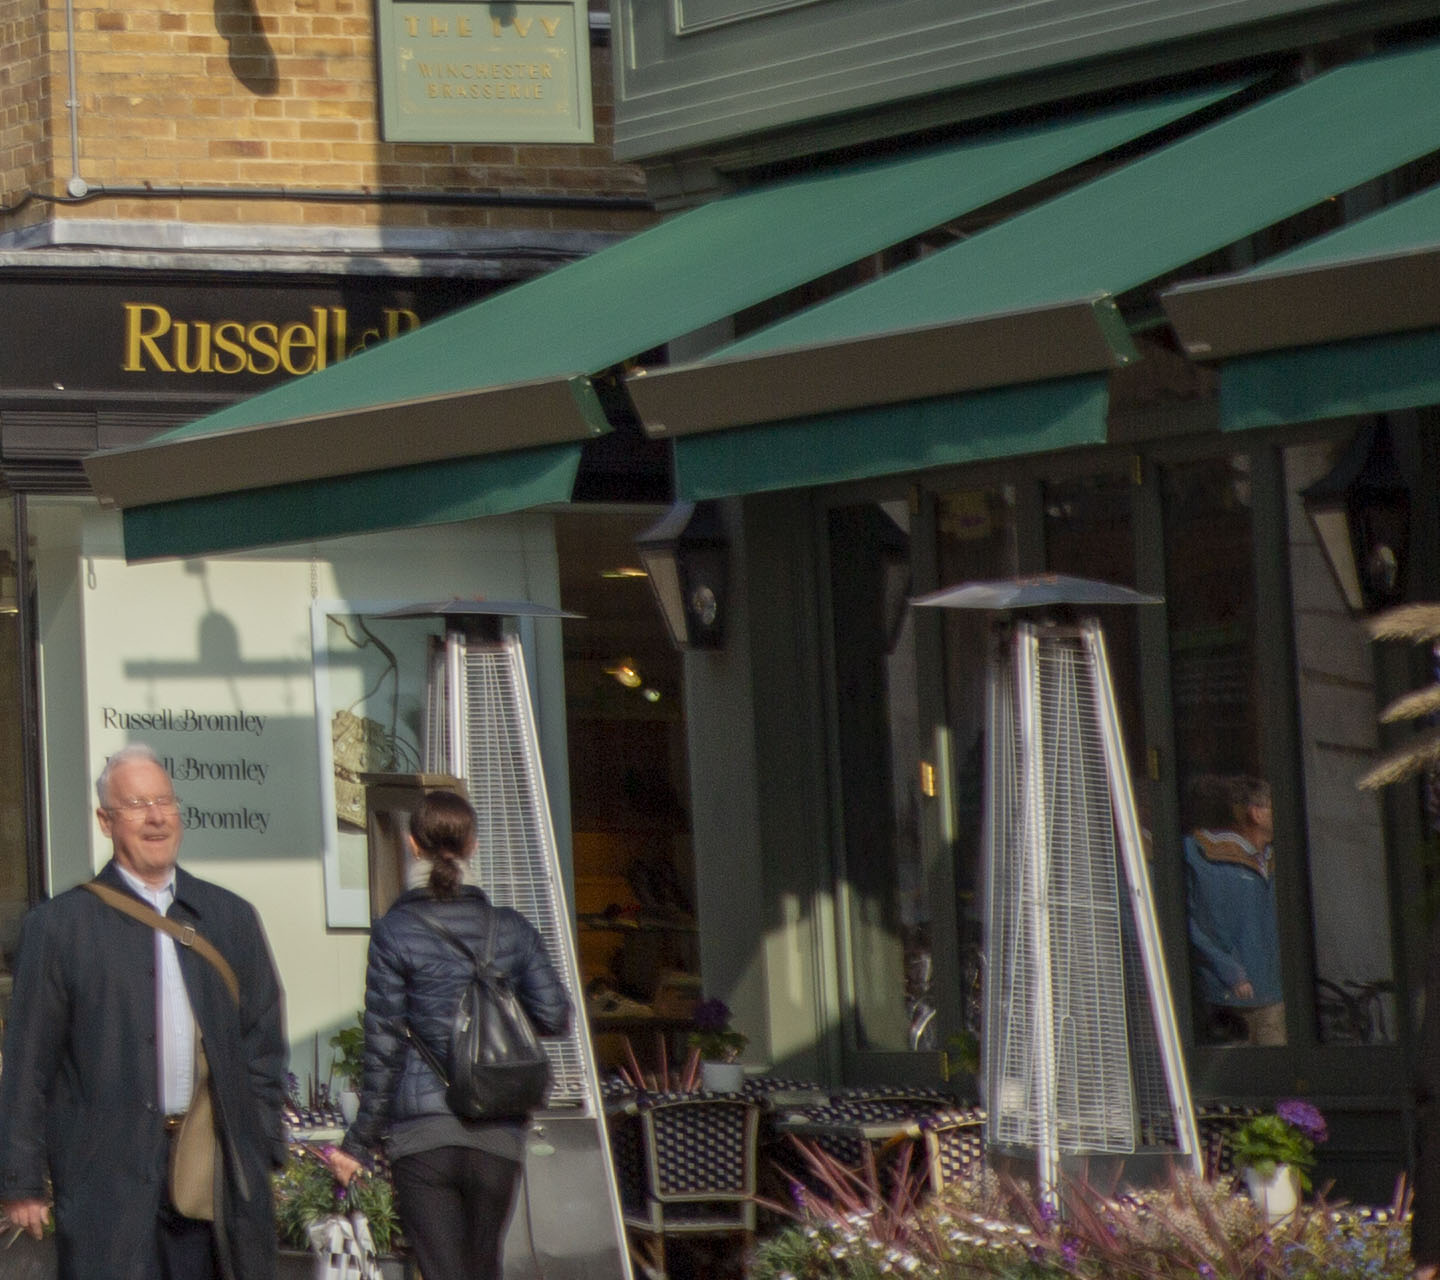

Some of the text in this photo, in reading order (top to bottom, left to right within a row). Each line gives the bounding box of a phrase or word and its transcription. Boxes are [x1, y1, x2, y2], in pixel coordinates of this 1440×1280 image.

[404, 15, 561, 39] THE IVY
[417, 62, 554, 80] WINCHESTER
[427, 83, 545, 100] BRASSERIE
[121, 302, 348, 375] Russell
[102, 706, 173, 731] Russell
[184, 708, 267, 737] Bromley
[186, 757, 270, 785] Bromley
[187, 806, 271, 834] Bromley
